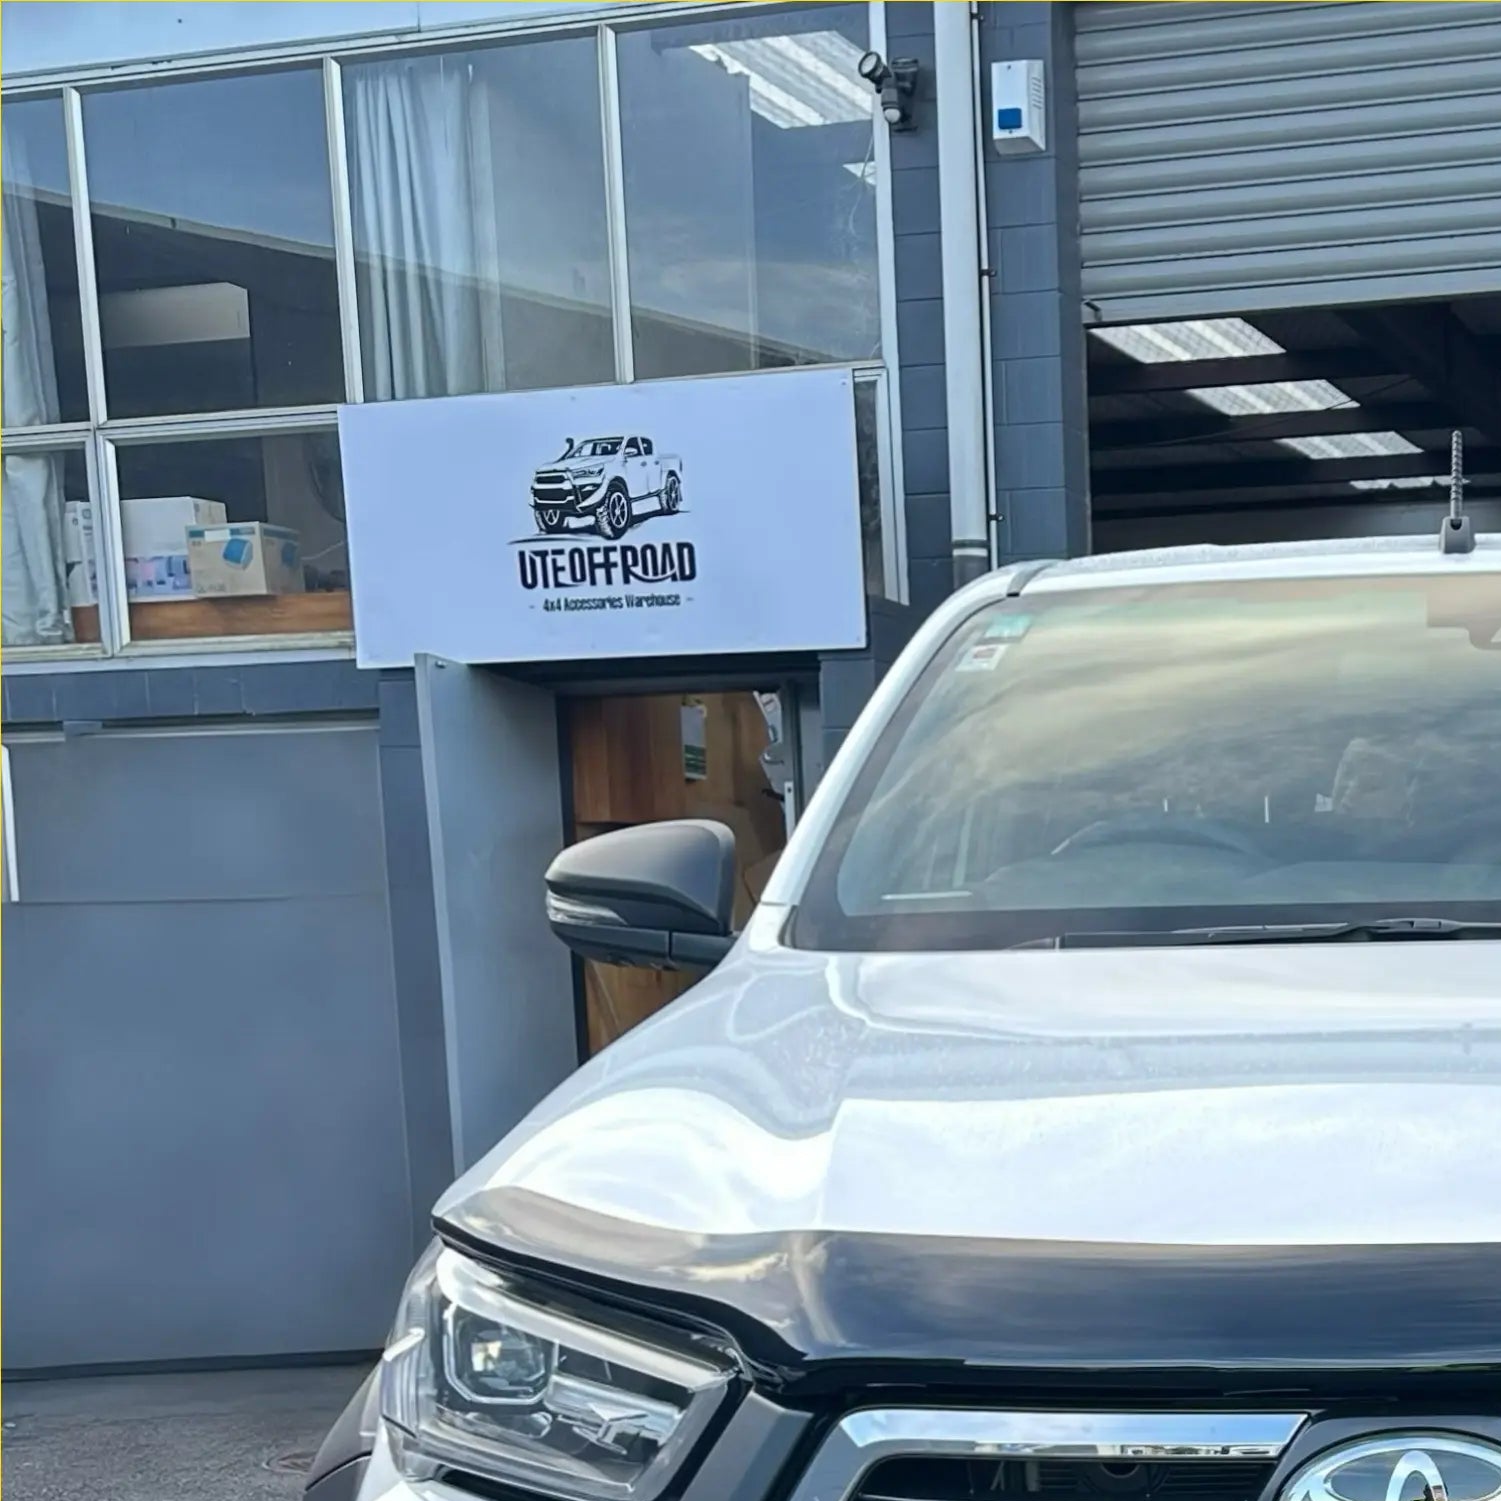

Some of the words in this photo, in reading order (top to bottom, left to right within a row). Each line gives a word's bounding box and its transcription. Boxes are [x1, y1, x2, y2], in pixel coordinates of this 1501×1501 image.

[543, 597, 562, 612] 4x4
[564, 594, 624, 612] Accessories
[625, 592, 681, 609] Warehouse
